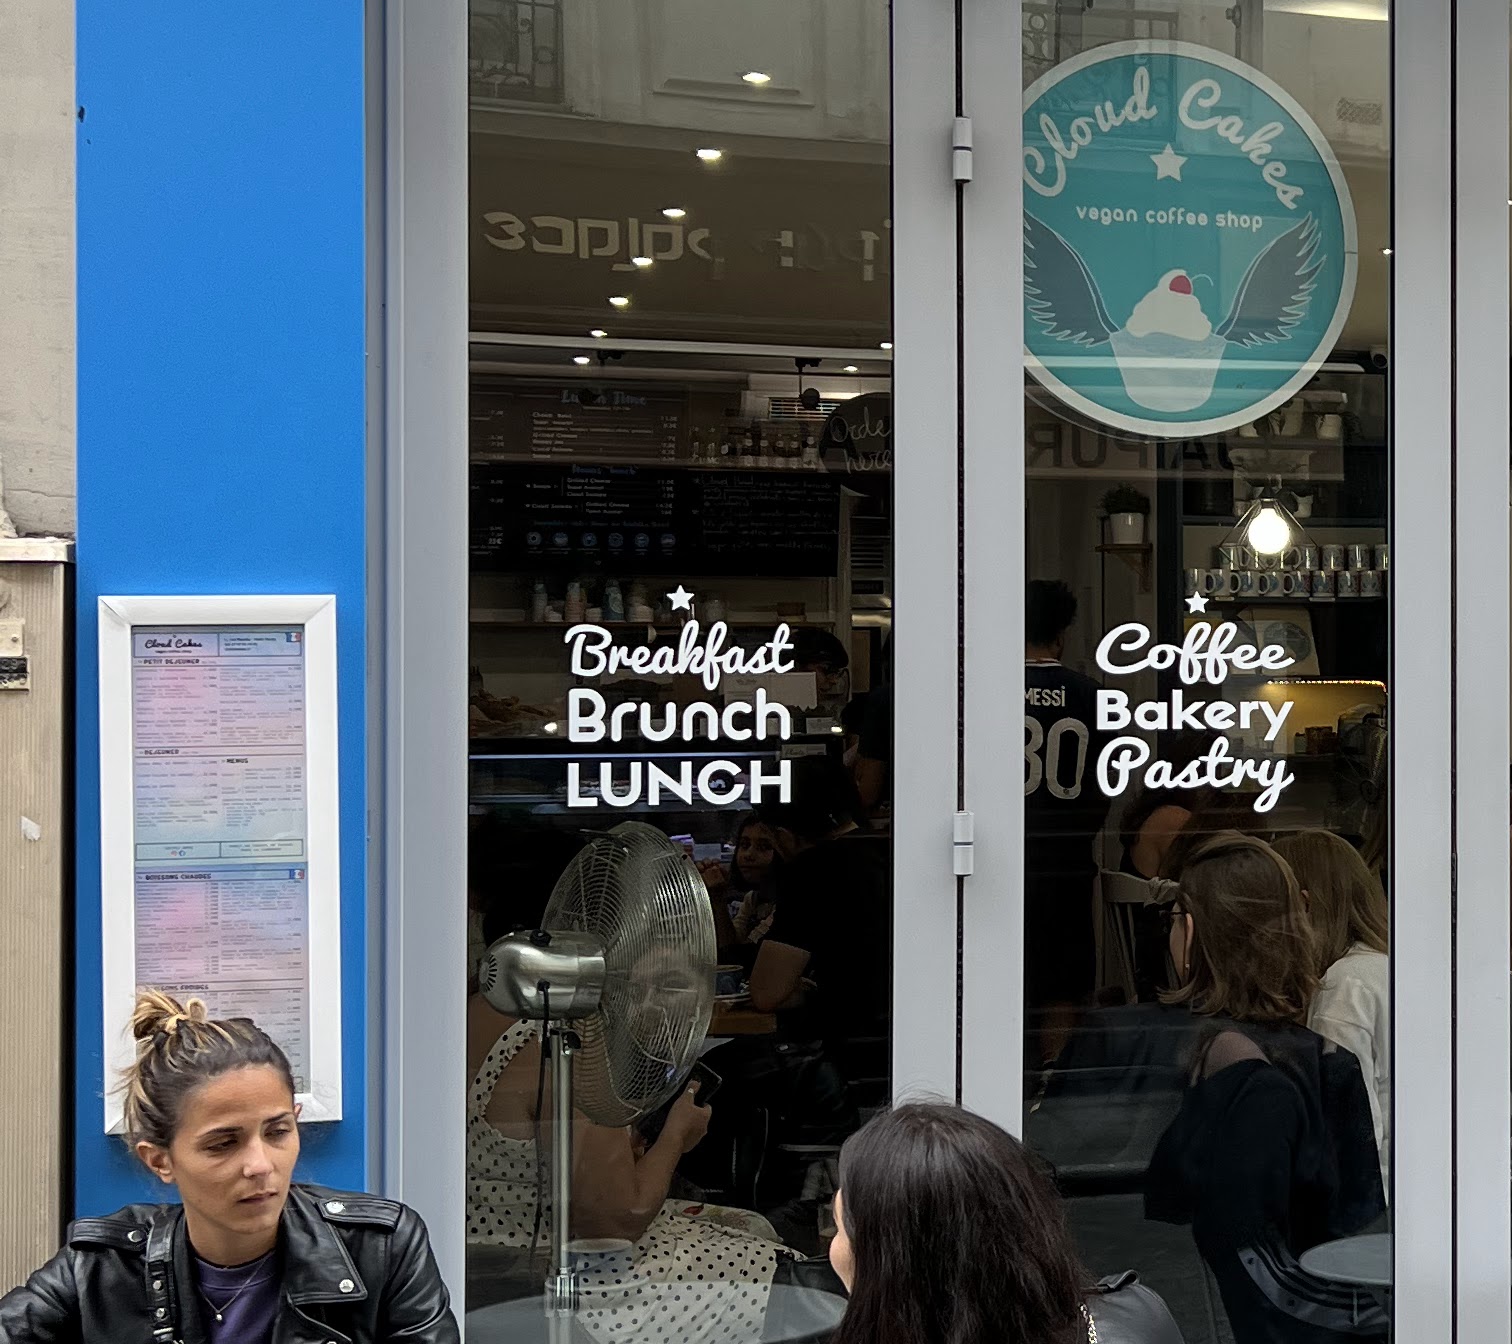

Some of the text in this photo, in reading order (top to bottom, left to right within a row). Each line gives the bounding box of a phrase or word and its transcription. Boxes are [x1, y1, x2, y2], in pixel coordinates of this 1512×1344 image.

[1023, 65, 1304, 210] Cloud Cakes
[1076, 205, 1264, 232] vegan coffee shop
[830, 406, 892, 443] Orde
[144, 638, 203, 649] Cloud Cakes
[564, 620, 795, 690] Breakfast
[1095, 621, 1295, 685] Coffee
[568, 688, 791, 743] Brunch
[1096, 689, 1294, 741] Bakery
[567, 759, 792, 807] LUNCH
[1096, 736, 1295, 812] Pastry
